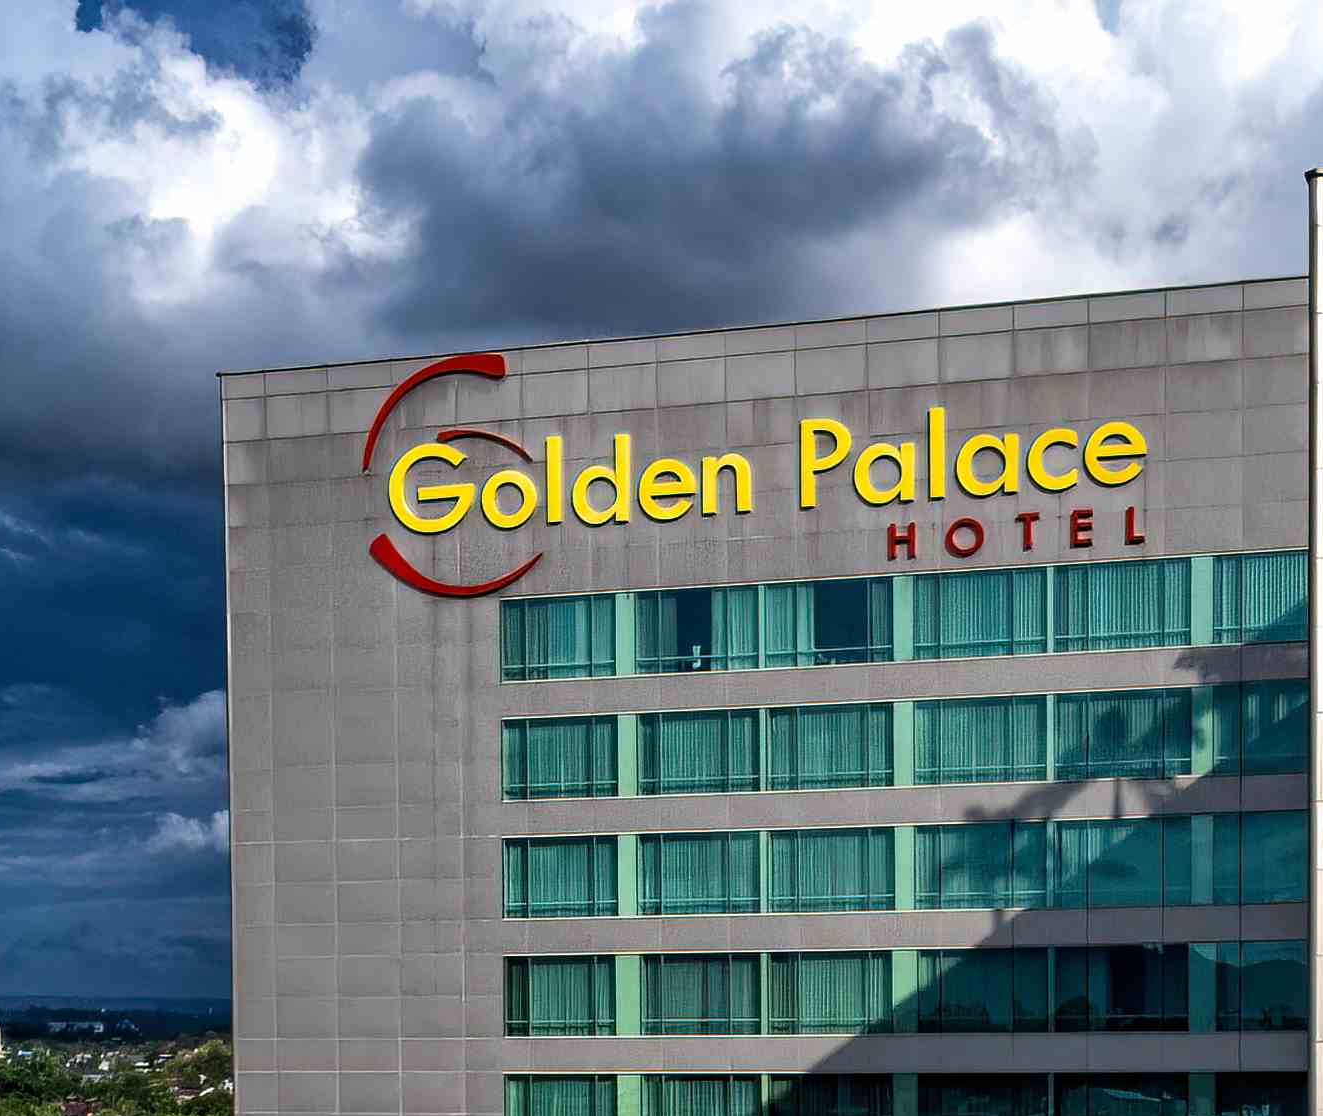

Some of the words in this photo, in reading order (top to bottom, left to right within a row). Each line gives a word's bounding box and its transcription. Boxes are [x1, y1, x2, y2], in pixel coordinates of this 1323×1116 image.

[390, 433, 753, 532] Golden
[801, 406, 1148, 506] Palace
[887, 506, 1143, 559] HOTEL
